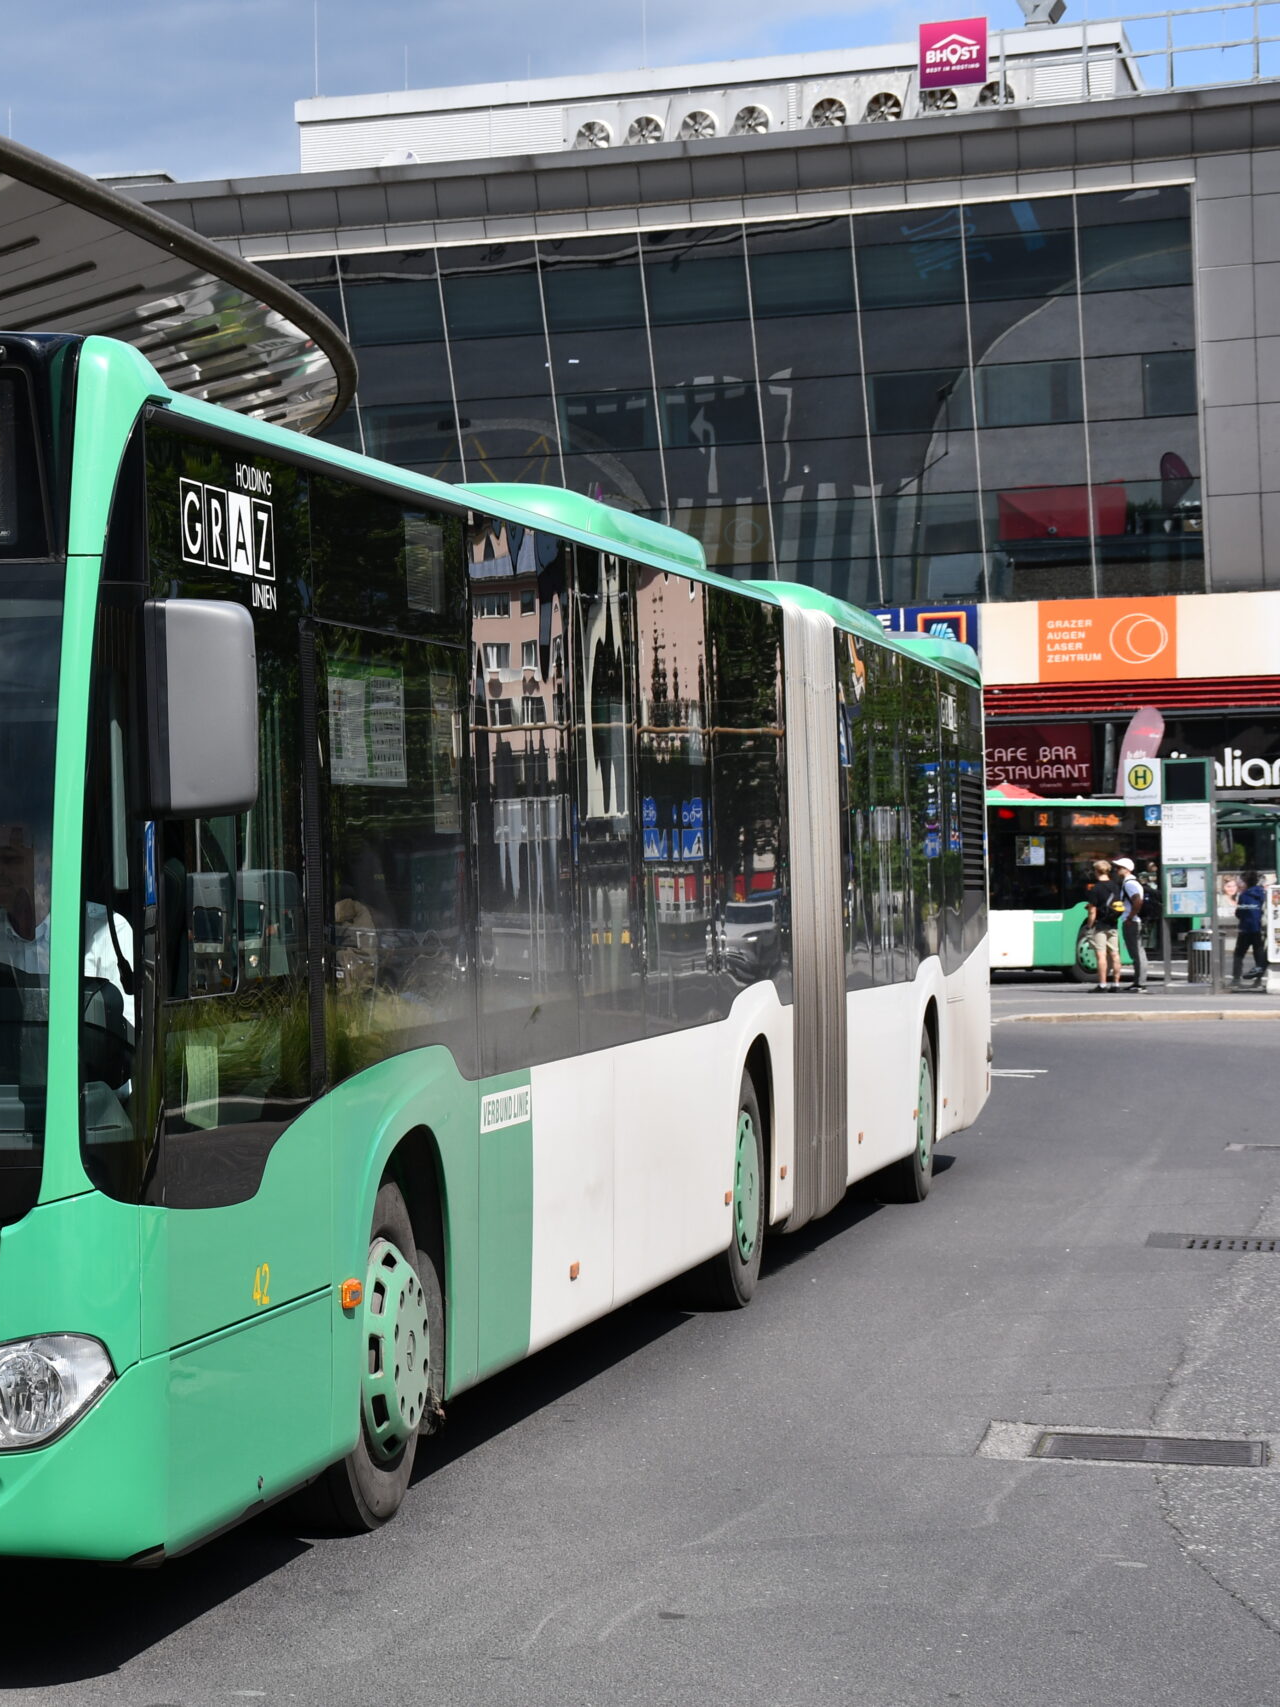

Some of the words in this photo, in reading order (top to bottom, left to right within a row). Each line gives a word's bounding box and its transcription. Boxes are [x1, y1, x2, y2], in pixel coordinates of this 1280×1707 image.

[925, 44, 981, 64] BHOST
[925, 66, 941, 74] BEST
[951, 63, 981, 71] HOSTING
[235, 462, 272, 496] HOLDING
[183, 490, 271, 572] GRAZ
[251, 582, 277, 611] LINIEN
[1046, 619, 1093, 629] GRAZER
[1046, 631, 1086, 640] AUGEN
[1046, 642, 1083, 652] LASER
[1046, 653, 1102, 663] ZENTRUM
[985, 747, 1028, 762] CAFE
[1039, 745, 1077, 761] BAR
[985, 763, 1090, 780] ESTAURANT
[1134, 769, 1147, 786] H
[483, 1096, 512, 1127] VERBUND
[513, 1090, 530, 1120] LINIE
[252, 1262, 270, 1306] 42
